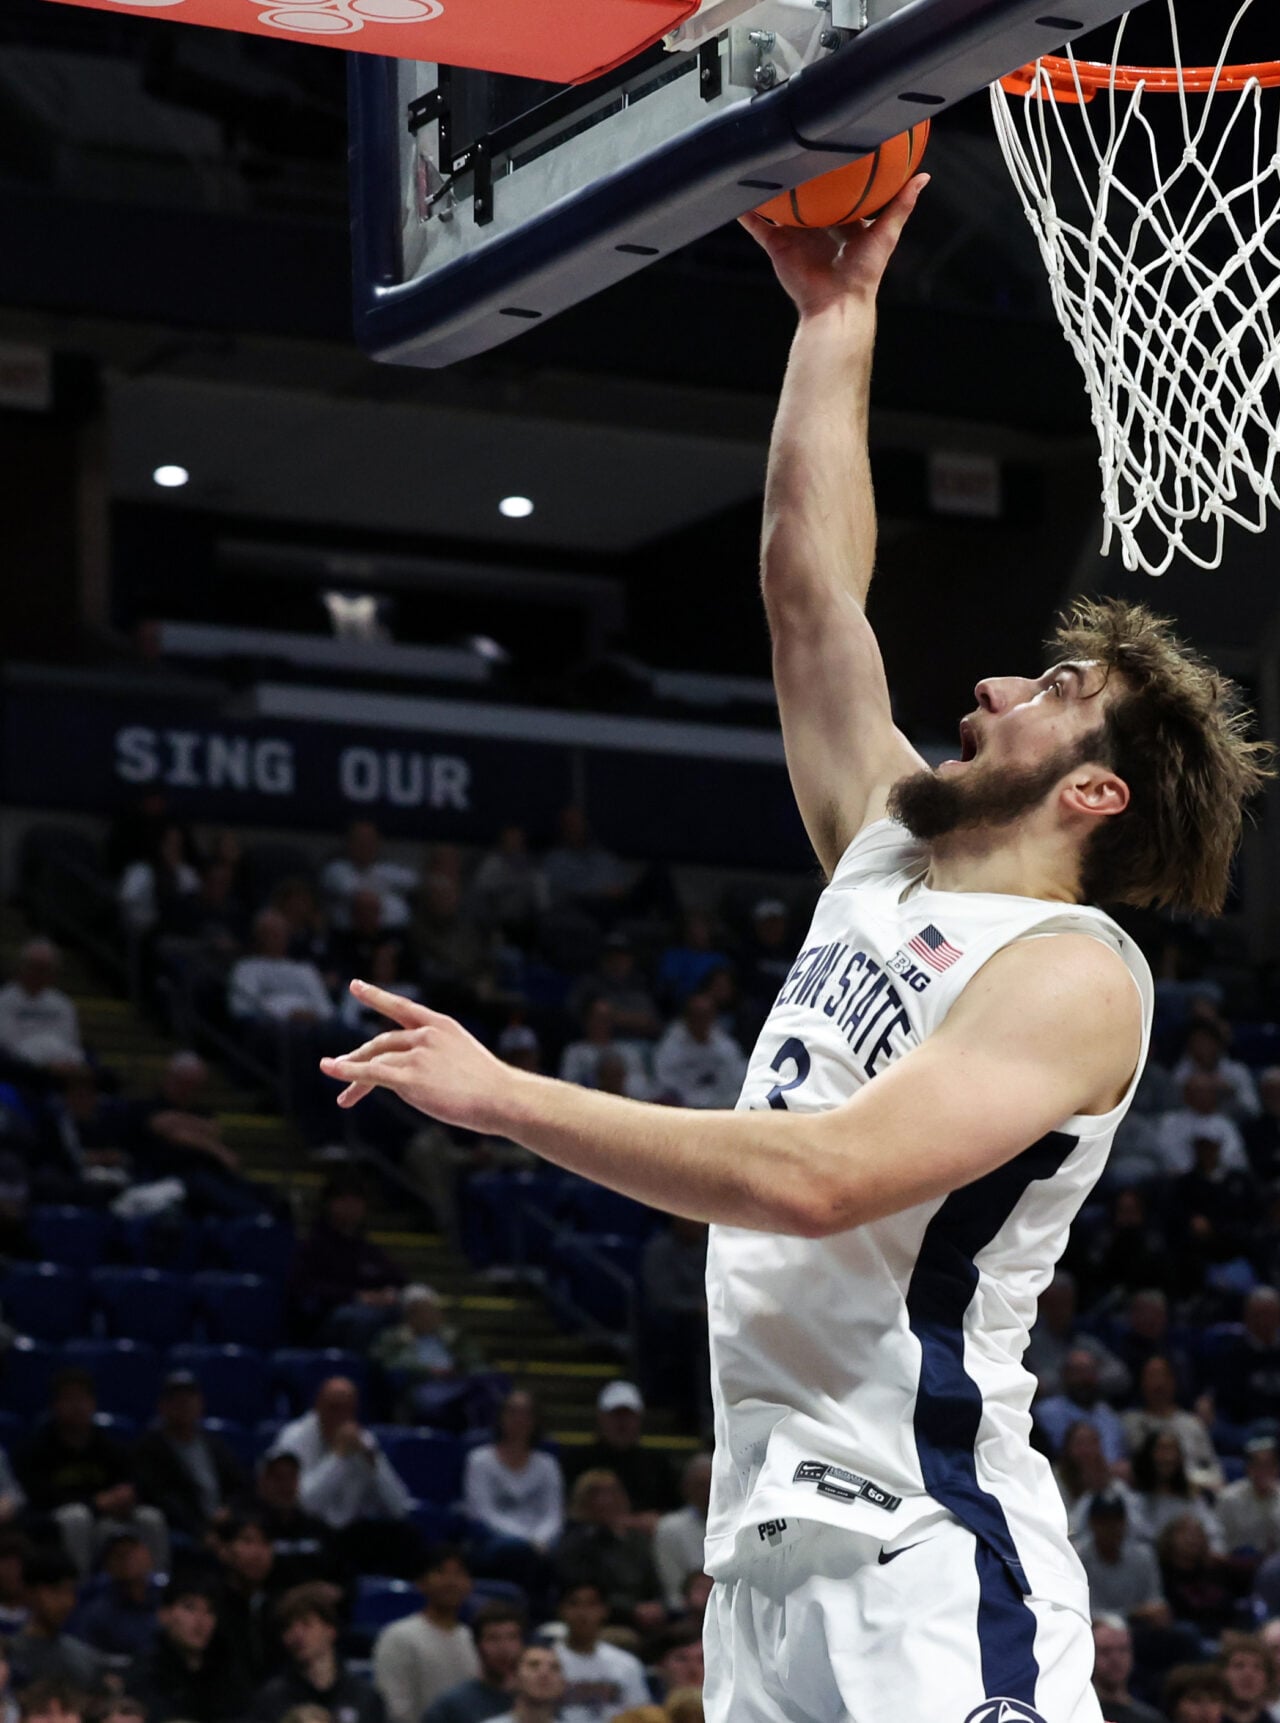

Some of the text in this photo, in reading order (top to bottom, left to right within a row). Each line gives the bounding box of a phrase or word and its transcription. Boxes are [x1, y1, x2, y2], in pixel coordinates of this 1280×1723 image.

[114, 726, 473, 811] SING OUR
[774, 942, 911, 1079] ENN STATE
[758, 1518, 787, 1541] PSU
